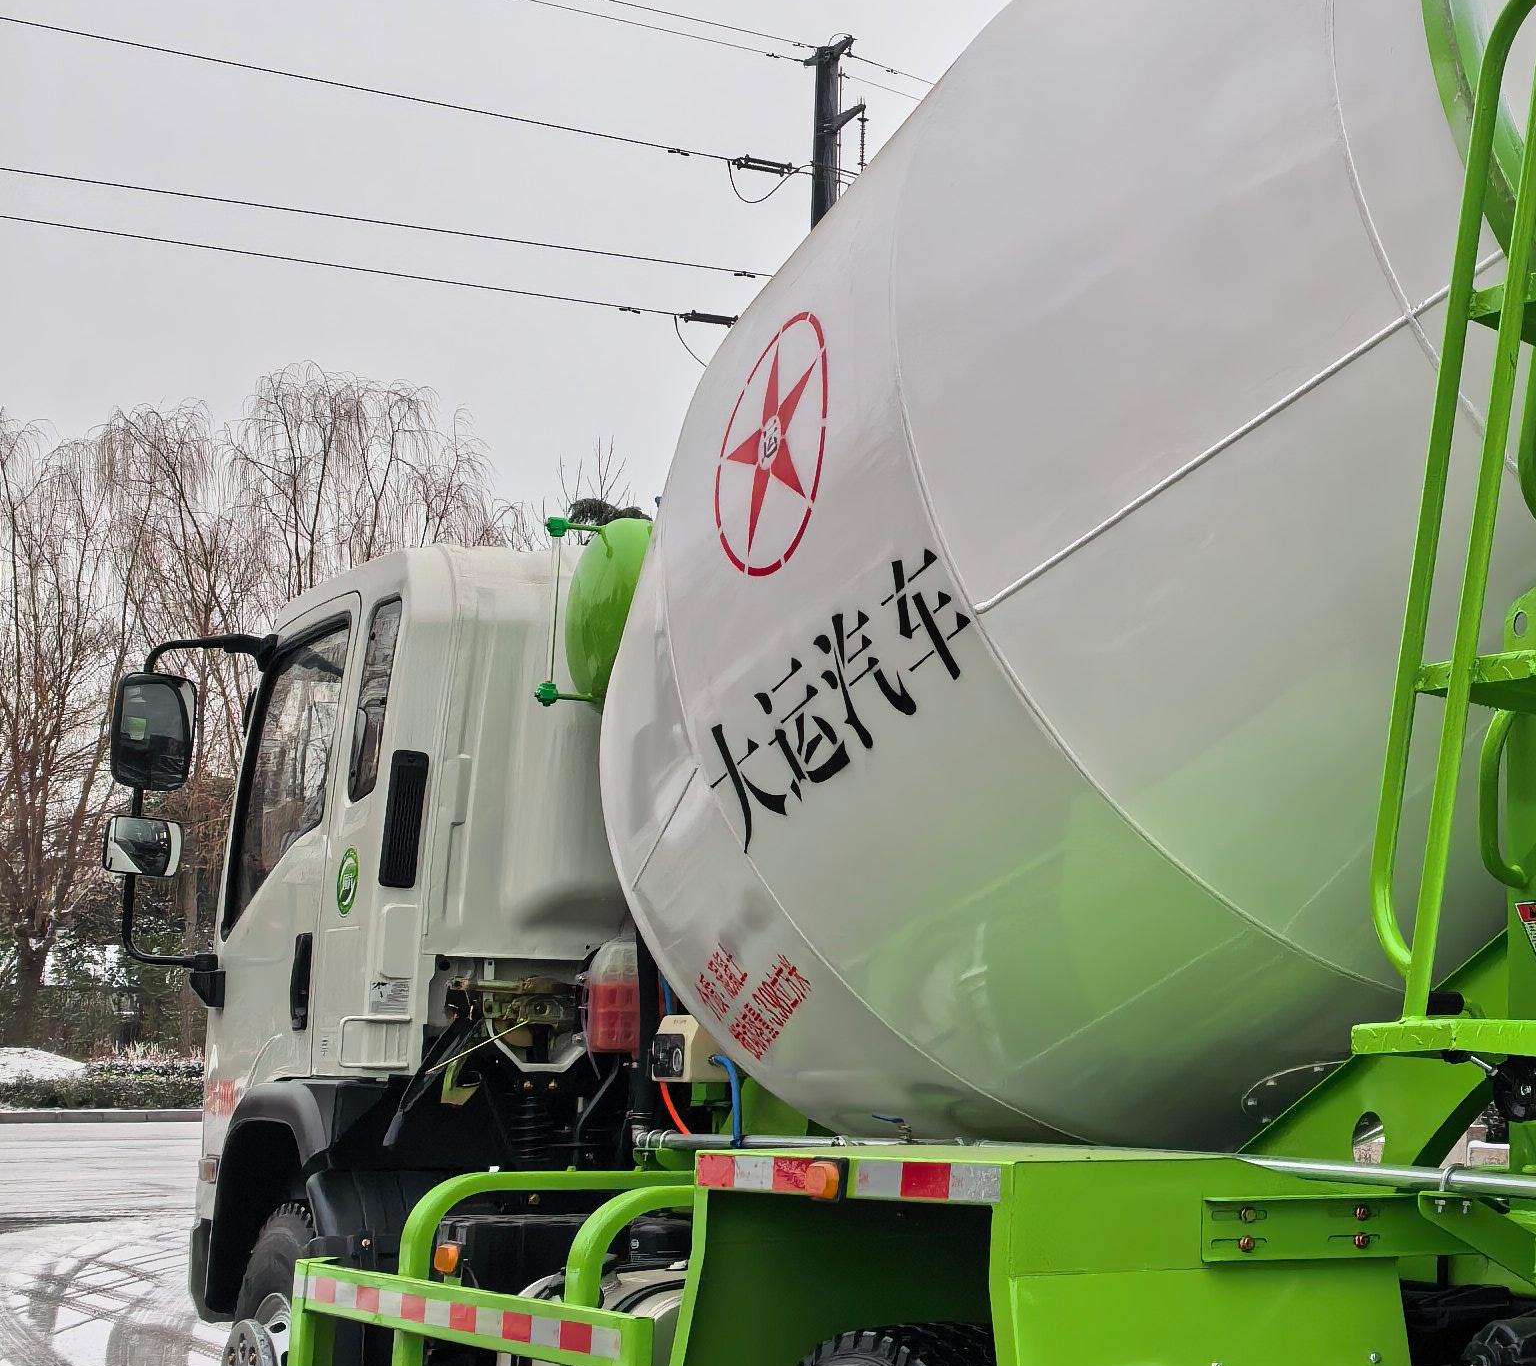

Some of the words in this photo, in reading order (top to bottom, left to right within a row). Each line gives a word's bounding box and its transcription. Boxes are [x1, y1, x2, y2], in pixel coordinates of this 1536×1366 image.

[761, 419, 778, 465] 运
[710, 548, 971, 854] 大运汽车
